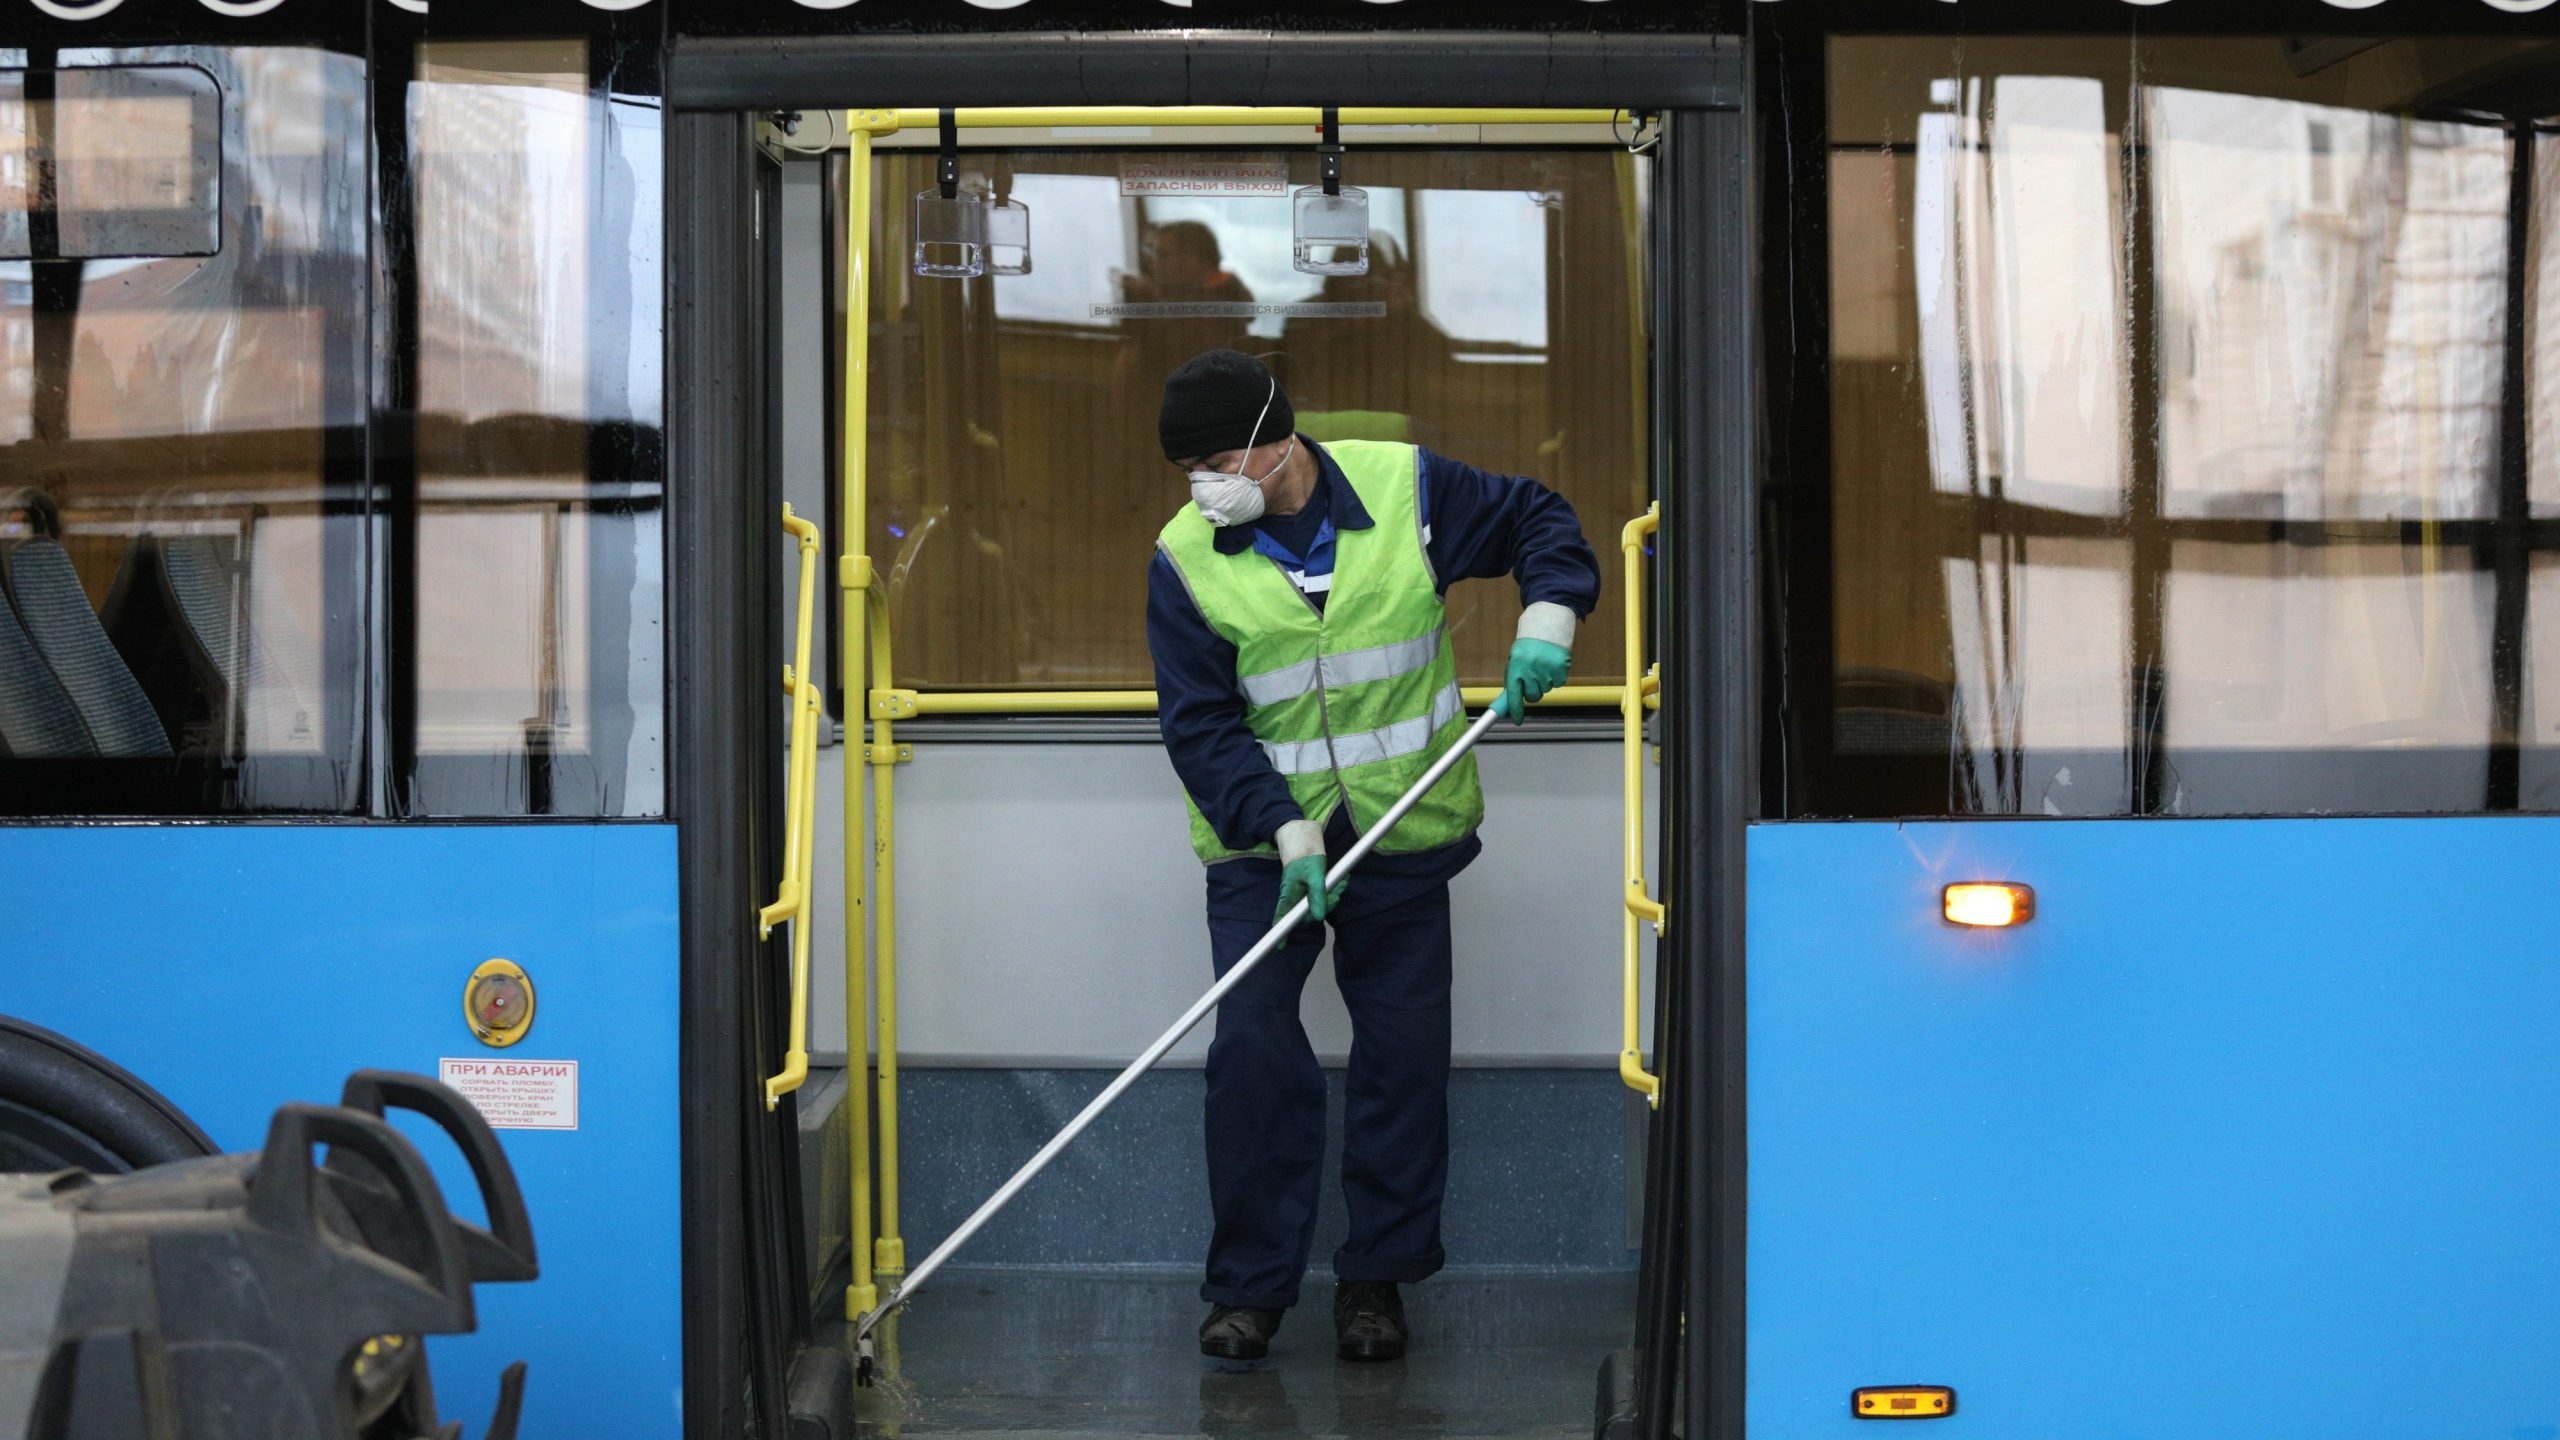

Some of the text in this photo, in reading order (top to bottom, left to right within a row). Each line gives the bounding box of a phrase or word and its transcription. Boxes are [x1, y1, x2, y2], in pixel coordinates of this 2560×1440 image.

[1125, 181, 1284, 192] ЗАПАСНЫЙ ВЫХОД
[1157, 306, 1164, 315] В
[1167, 305, 1220, 315] АВТОБУСЕ
[450, 1064, 568, 1077] ПРИ АВАРИИ
